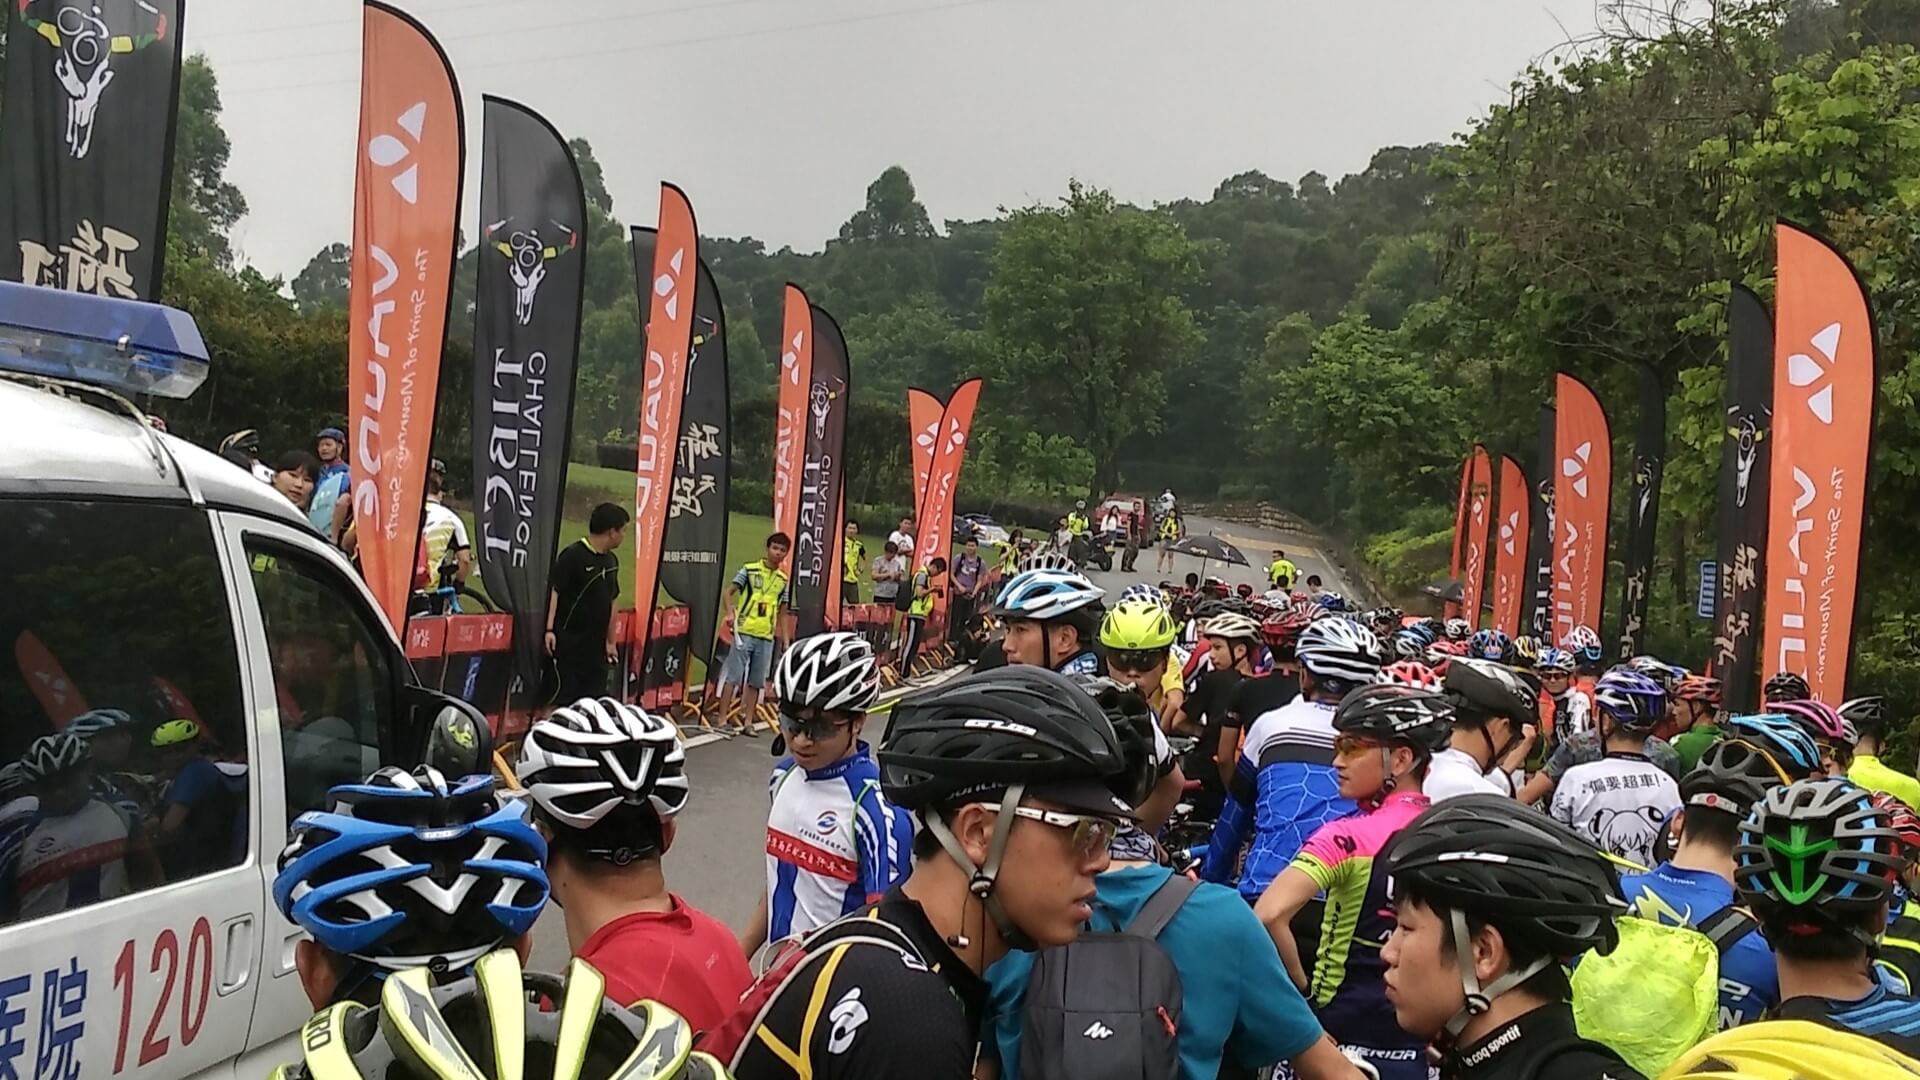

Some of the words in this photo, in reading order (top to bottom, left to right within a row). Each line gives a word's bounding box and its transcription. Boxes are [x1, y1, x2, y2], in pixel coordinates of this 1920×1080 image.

[112, 915, 214, 1076] 120
[1472, 1047, 1491, 1064] coq
[1487, 1024, 1522, 1054] sportif
